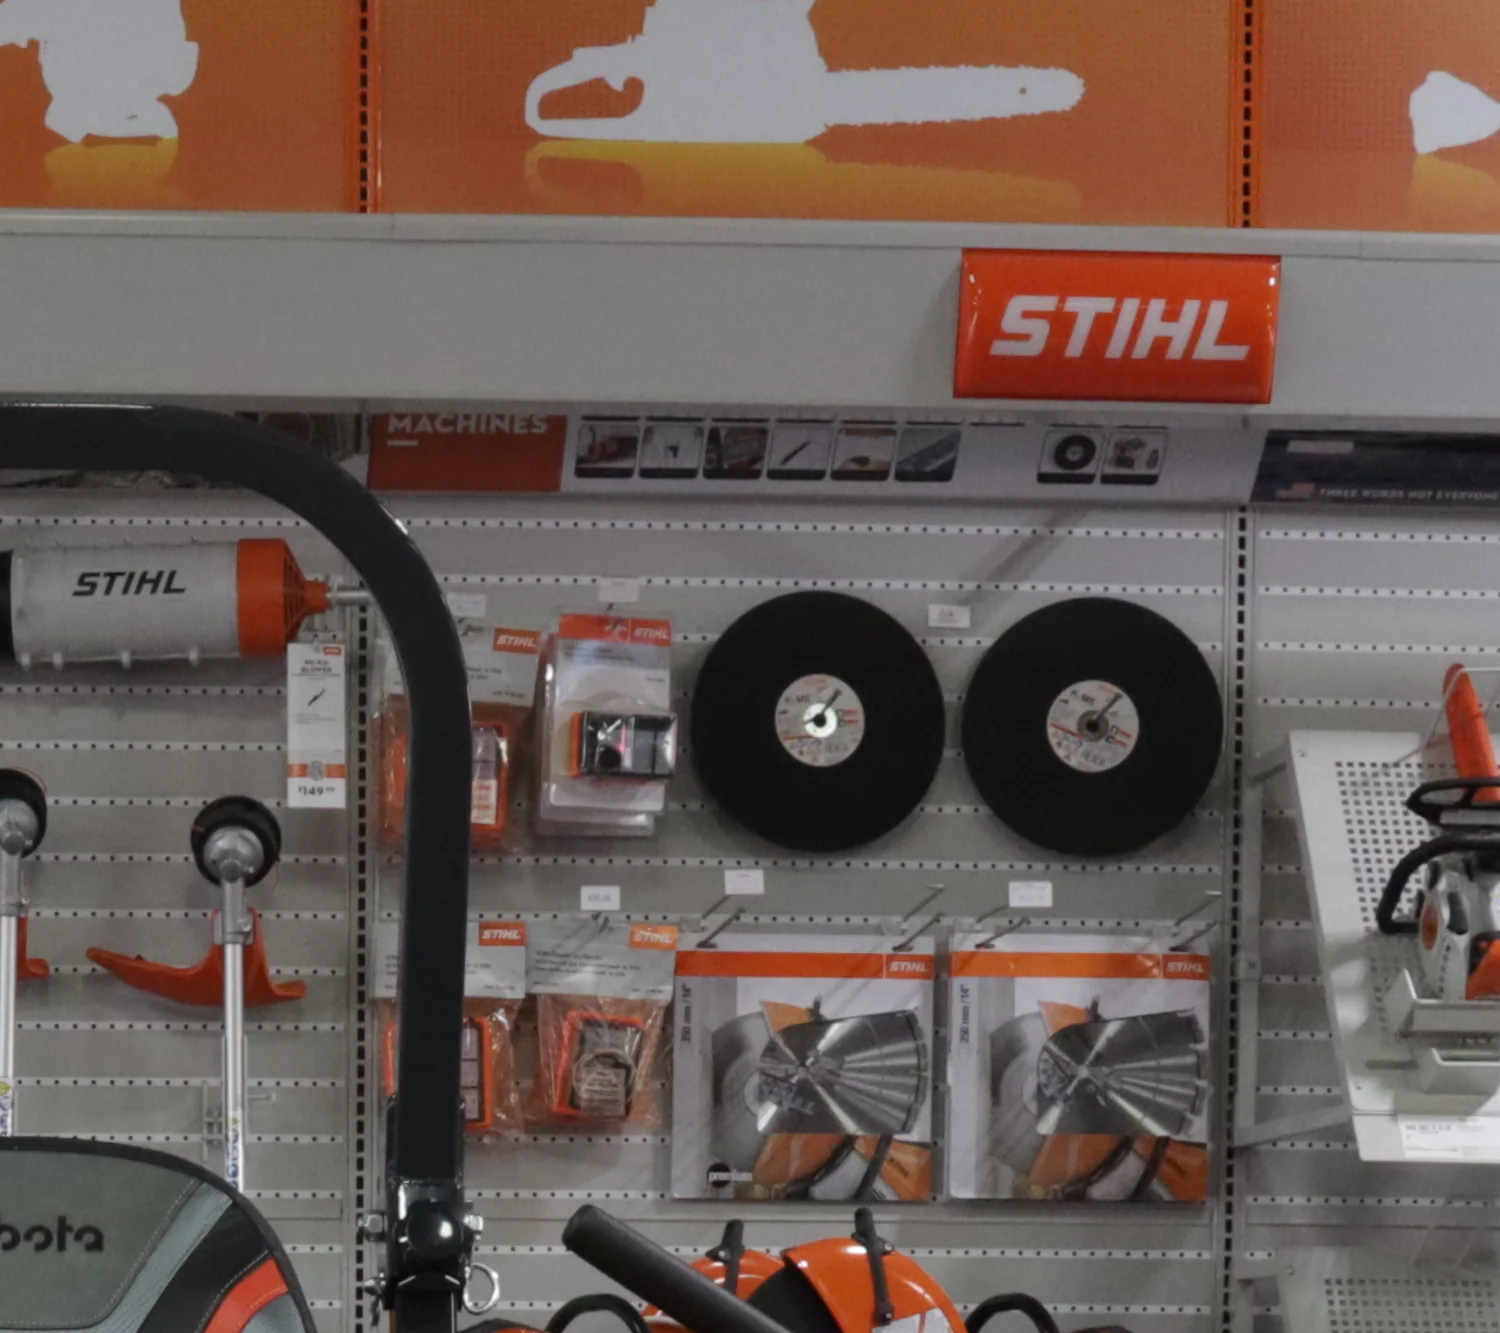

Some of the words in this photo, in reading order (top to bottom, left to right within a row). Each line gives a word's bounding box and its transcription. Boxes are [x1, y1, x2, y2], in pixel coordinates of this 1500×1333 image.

[990, 295, 1251, 361] STIHL
[387, 413, 548, 434] MACHINES
[73, 569, 187, 598] STIHL
[632, 627, 669, 640] STIHL
[496, 634, 537, 648] STIHL
[482, 928, 522, 940] STIHL
[632, 931, 673, 944] STIHL
[889, 960, 930, 973] STIHL
[1166, 961, 1205, 974] STIHL
[709, 1169, 753, 1182] premium
